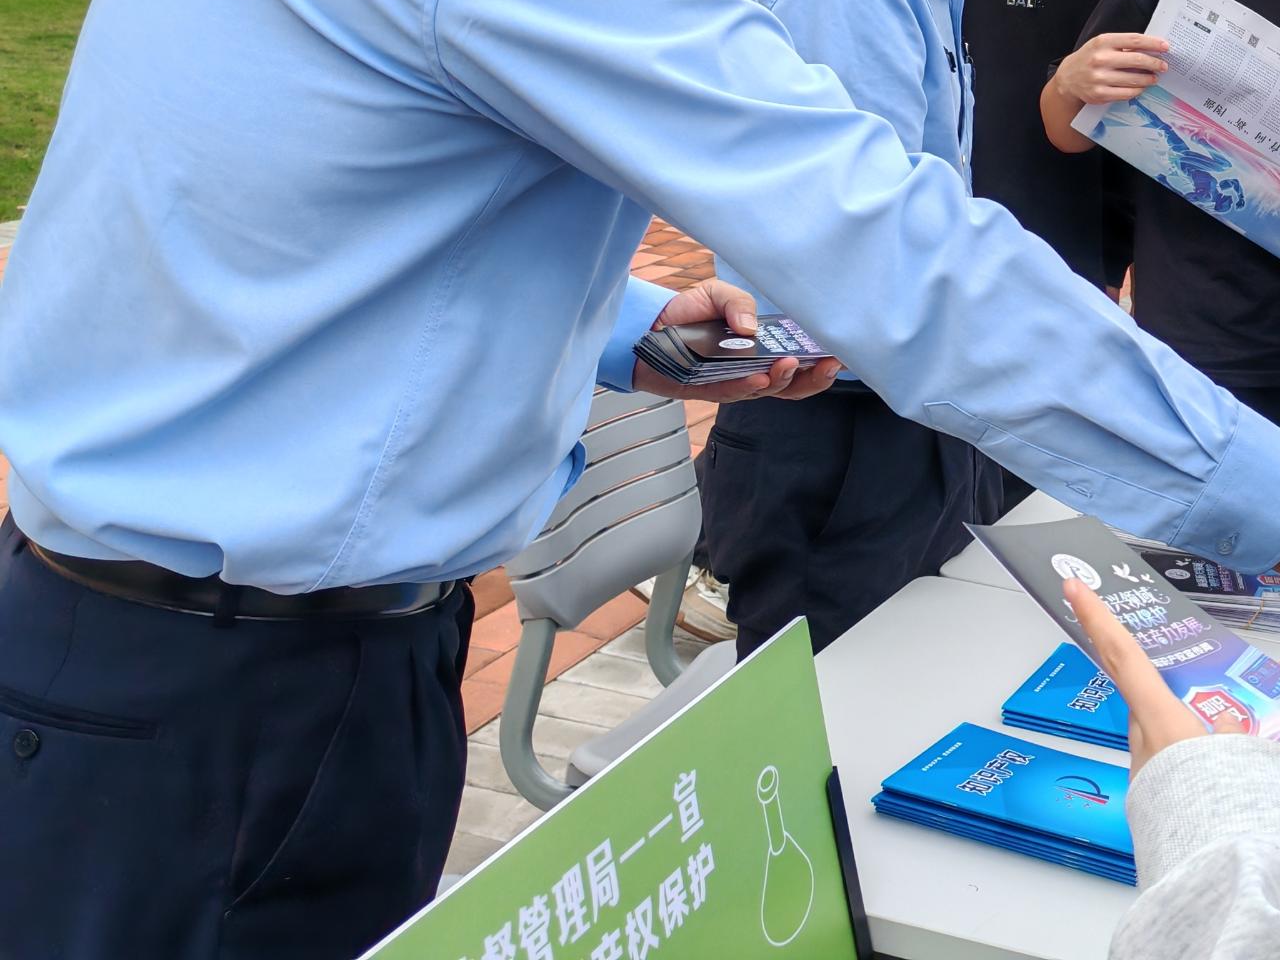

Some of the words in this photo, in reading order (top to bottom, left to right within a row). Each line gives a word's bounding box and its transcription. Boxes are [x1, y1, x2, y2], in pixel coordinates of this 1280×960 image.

[1132, 616, 1203, 651] 生产力发展
[1067, 672, 1115, 712] 知识产
[956, 749, 1035, 796] 知识产权
